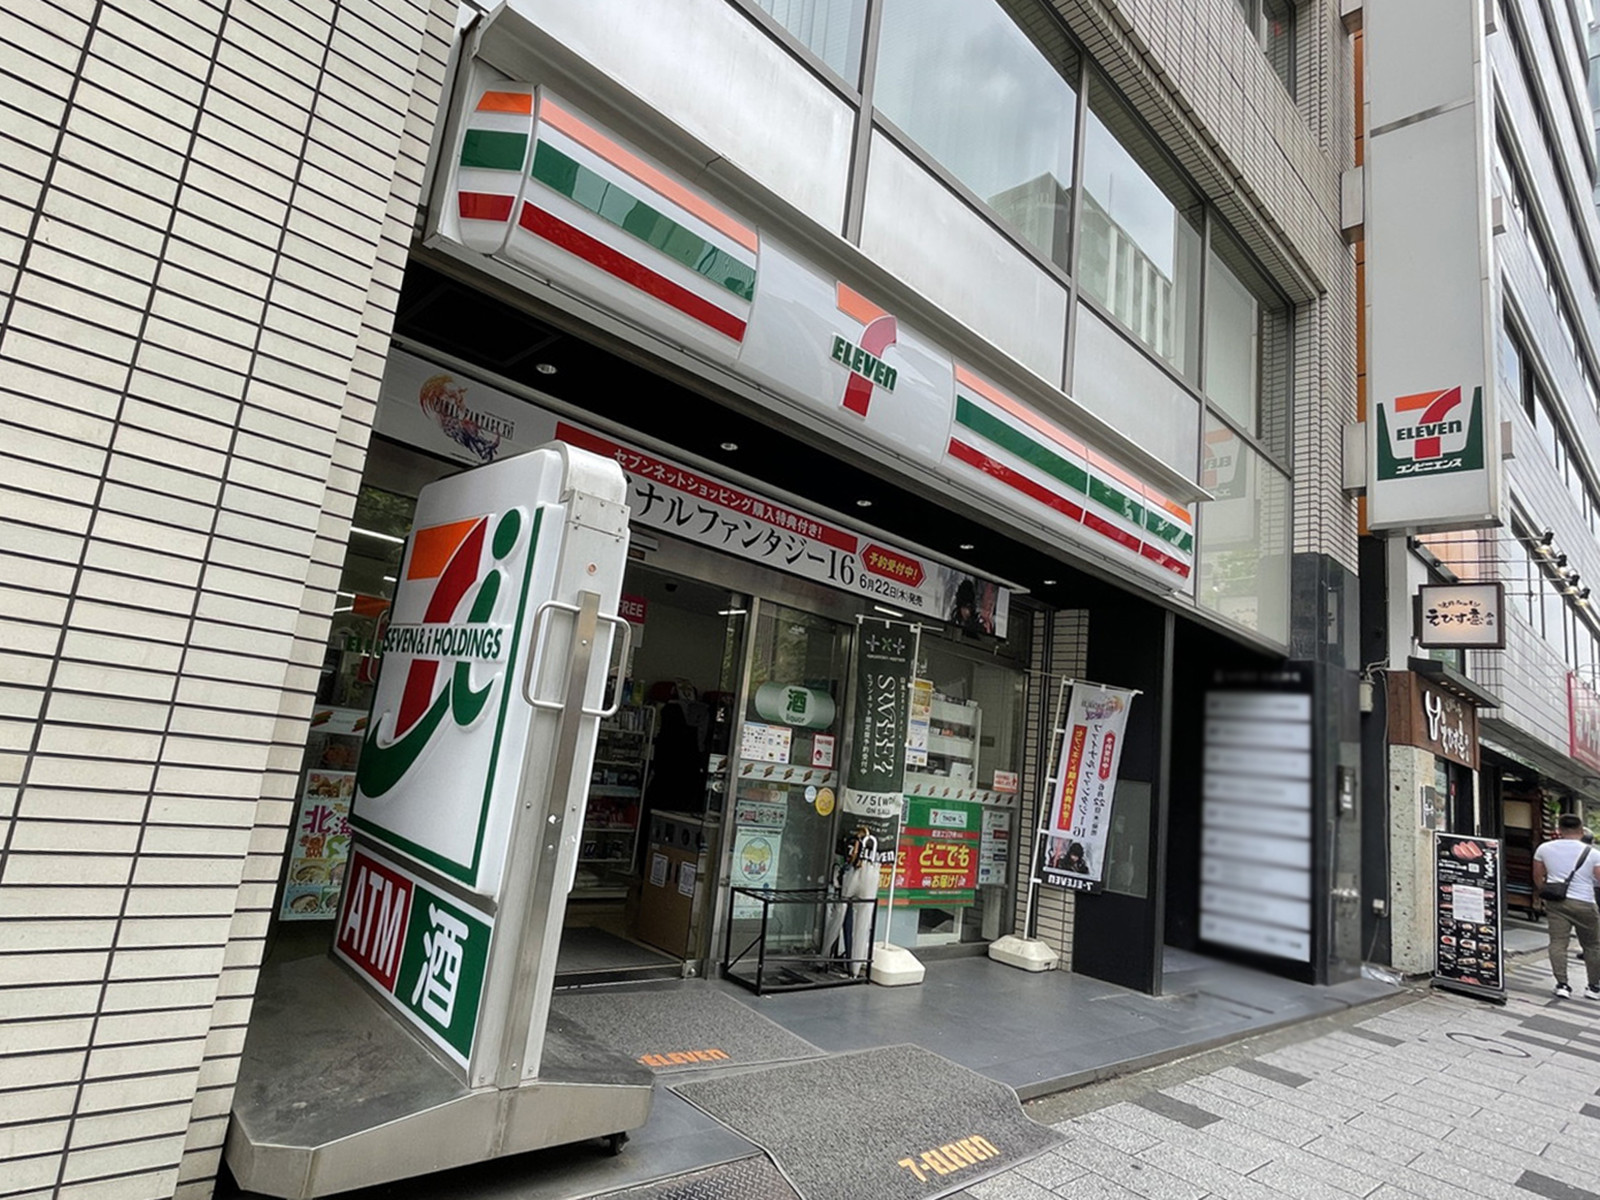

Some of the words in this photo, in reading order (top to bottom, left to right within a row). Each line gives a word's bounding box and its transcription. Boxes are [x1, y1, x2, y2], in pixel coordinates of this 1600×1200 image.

[1396, 458, 1462, 475] コンビニエンス
[625, 473, 855, 586] ナルファンタジー16
[869, 551, 919, 581] 予約受付中!
[431, 627, 503, 660] HOLDINGS
[786, 688, 808, 715] 酒
[920, 842, 970, 867] どこでも
[342, 865, 407, 978] ATM
[411, 902, 469, 1029] 酒
